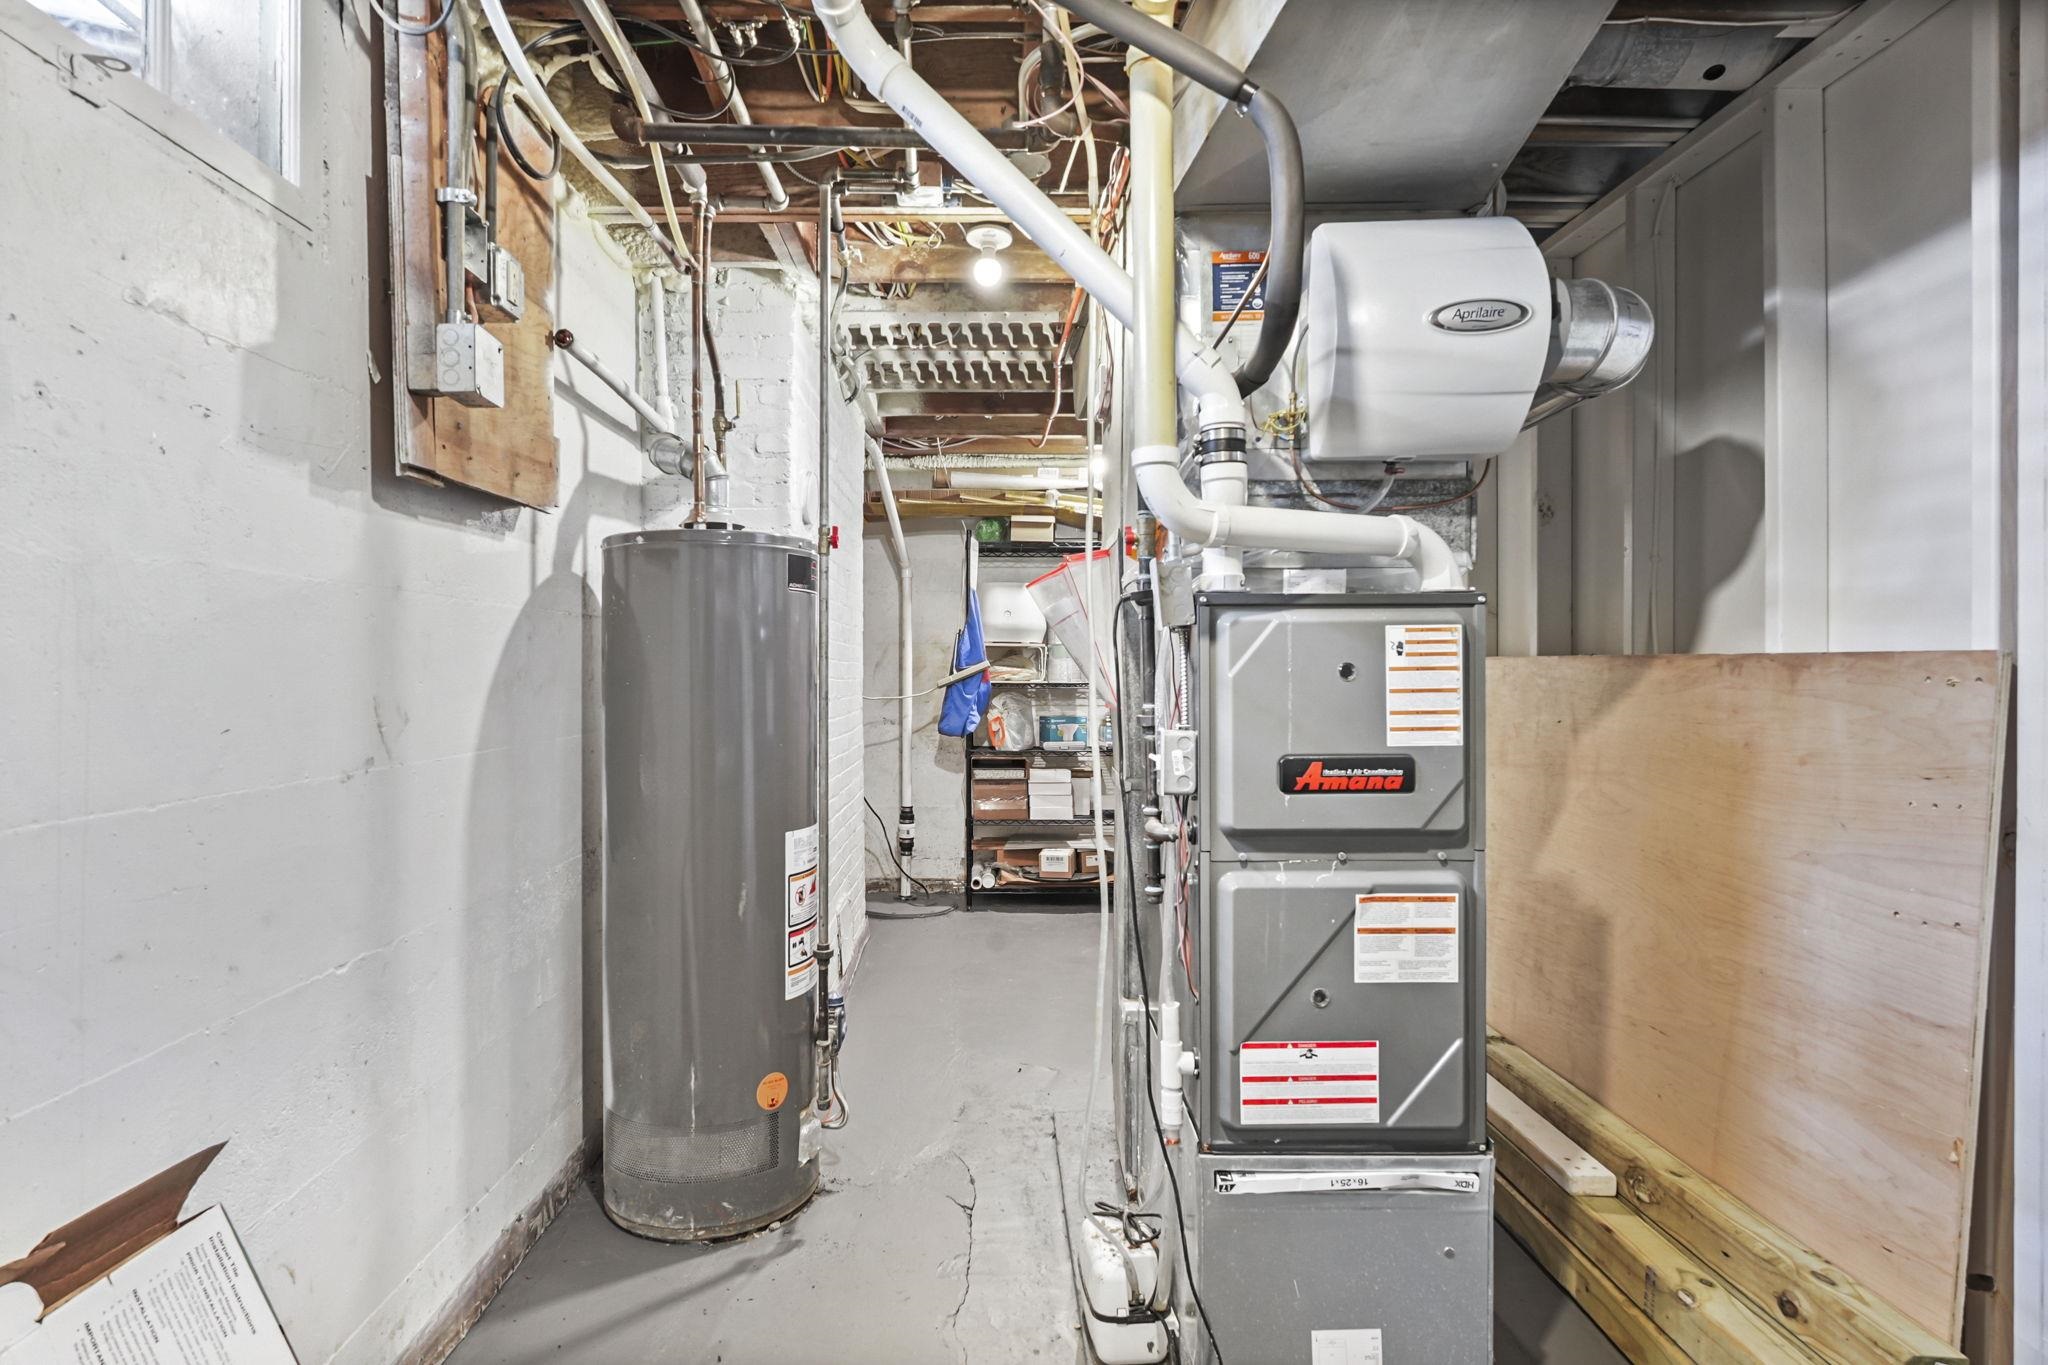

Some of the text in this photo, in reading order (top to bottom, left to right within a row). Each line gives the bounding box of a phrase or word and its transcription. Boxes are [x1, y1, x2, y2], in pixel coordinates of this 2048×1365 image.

[1452, 306, 1505, 322] Aprilaire
[1294, 762, 1404, 790] Amana
[1455, 1180, 1474, 1189] HDX
[216, 1230, 239, 1278] Carpet Tile
[186, 1250, 227, 1338] PRIOR TO INSTALLATION
[208, 1235, 256, 1334] Installation Instructions
[131, 1287, 159, 1343] INSTALLATION
